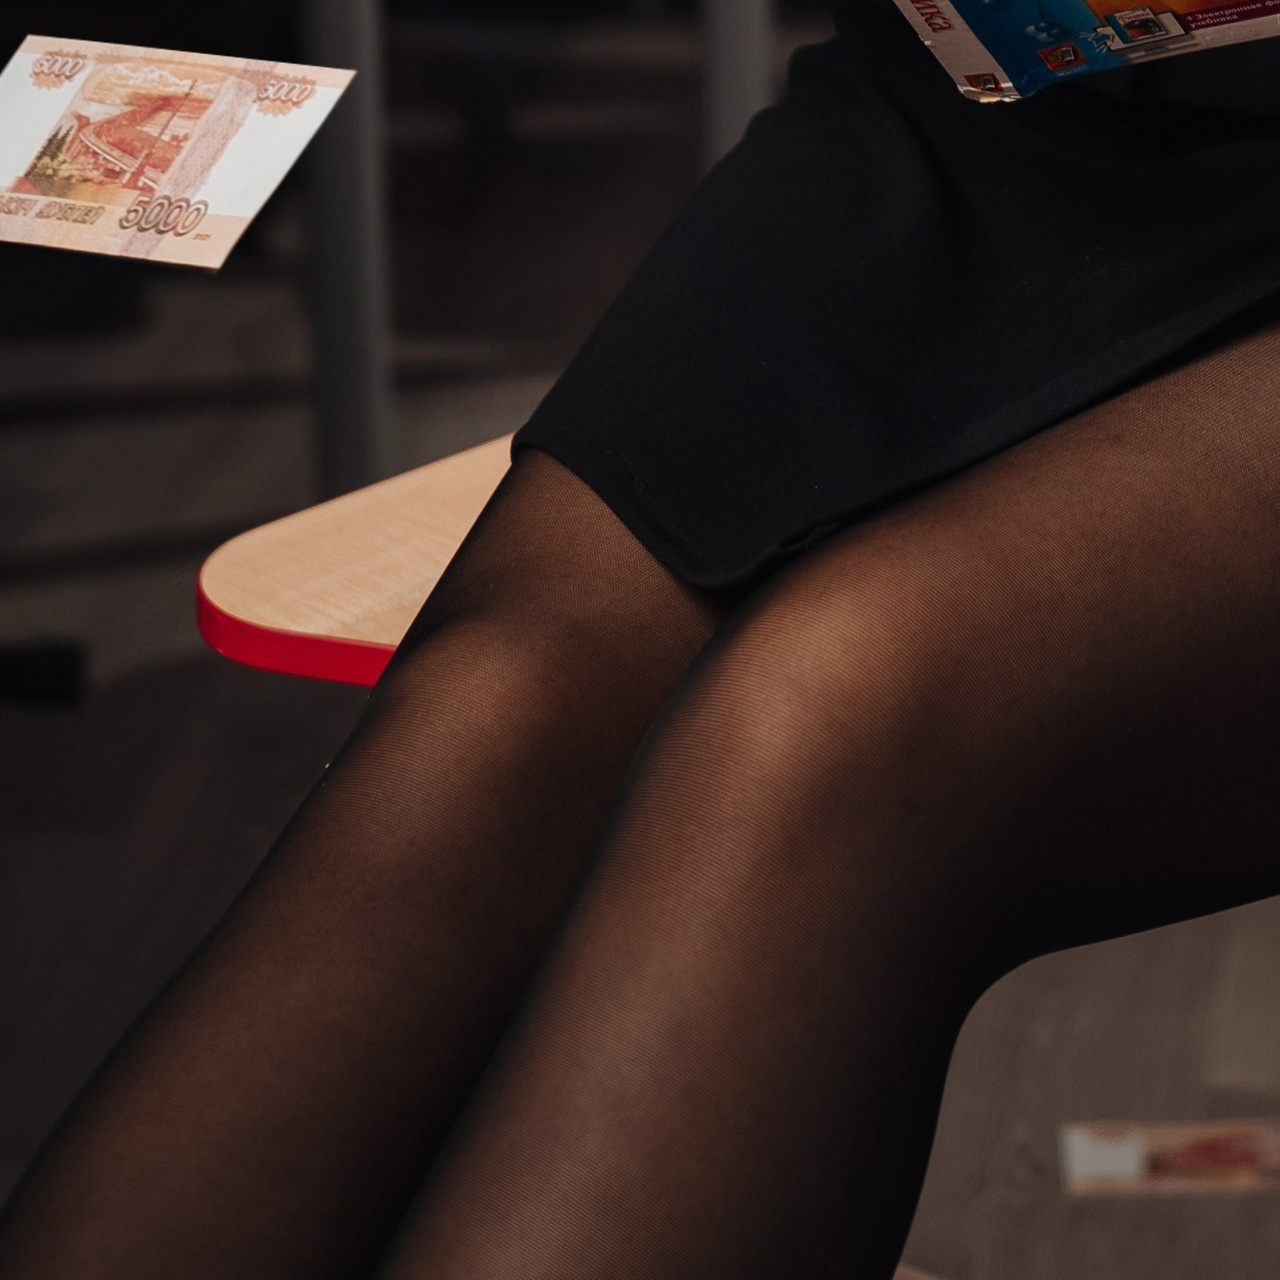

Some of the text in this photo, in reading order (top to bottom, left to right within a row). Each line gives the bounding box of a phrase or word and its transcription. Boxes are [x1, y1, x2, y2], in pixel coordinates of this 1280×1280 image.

[1197, 2, 1262, 21] Электронная
[1189, 14, 1239, 29] учебника
[119, 194, 210, 237] 5000
